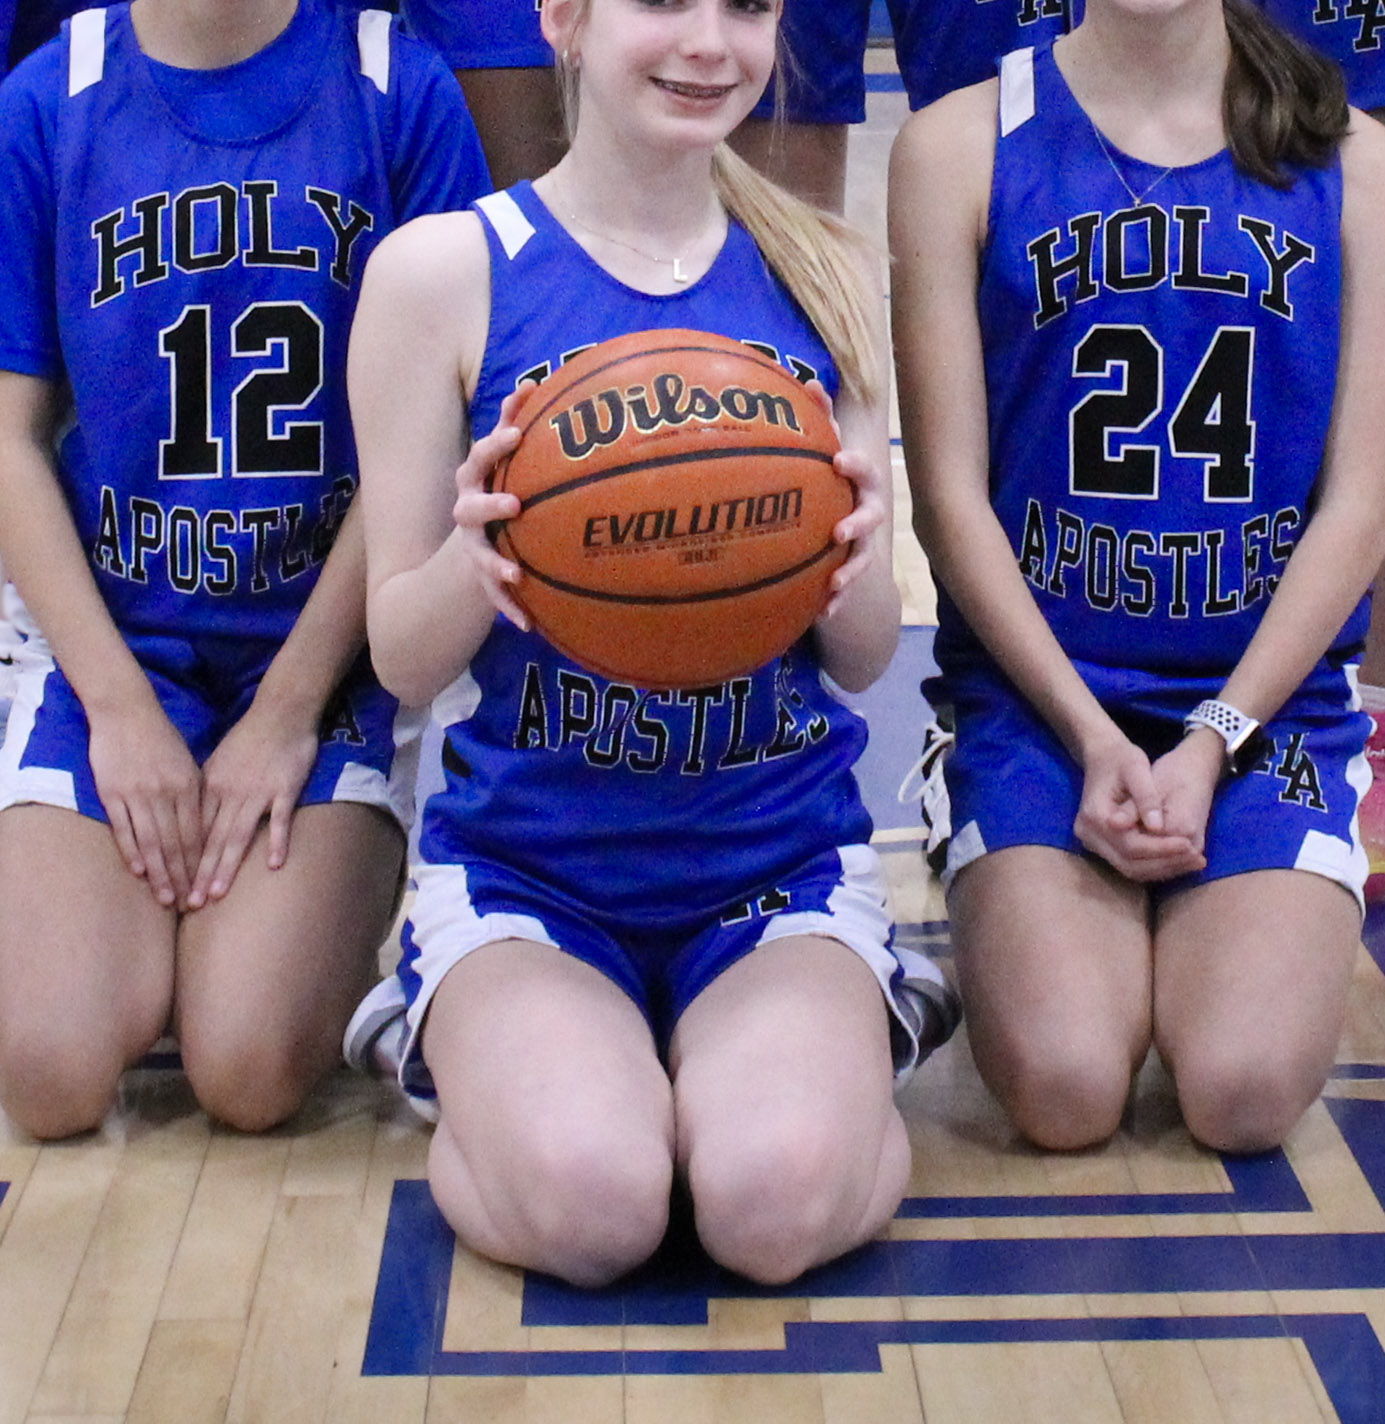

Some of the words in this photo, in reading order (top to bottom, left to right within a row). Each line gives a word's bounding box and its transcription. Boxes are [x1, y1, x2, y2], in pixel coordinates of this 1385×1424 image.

[90, 180, 374, 309] HOLY
[1026, 203, 1315, 330] HOLY
[158, 300, 324, 481] 12
[549, 373, 805, 461] Wilson
[1068, 323, 1256, 503] 24
[583, 486, 804, 548] EVOLUTION
[1019, 498, 1301, 618] APOSTLES
